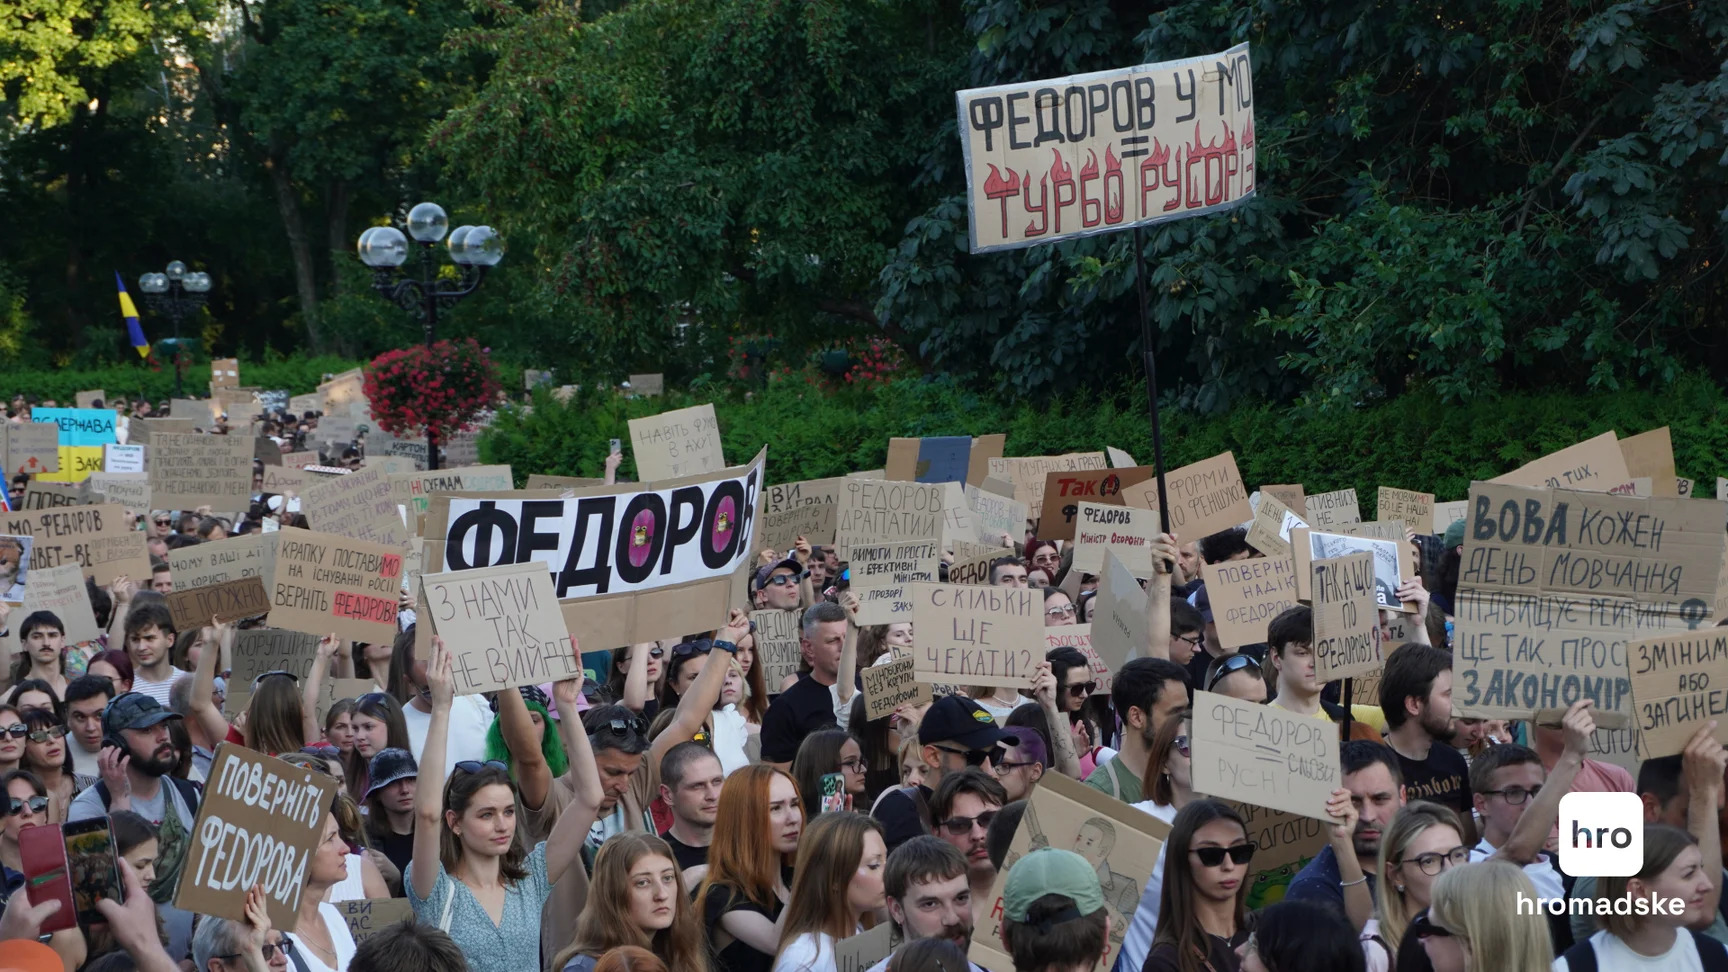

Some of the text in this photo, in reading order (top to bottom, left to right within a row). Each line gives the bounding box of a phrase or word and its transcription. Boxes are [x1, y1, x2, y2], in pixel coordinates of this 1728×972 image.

[969, 54, 1251, 151] ФЕДОРОВ У МО
[984, 160, 1125, 239] ТУРБО
[637, 423, 689, 447] НАВІТЬ
[75, 456, 103, 472] ЗАК
[669, 442, 680, 458] В
[991, 459, 1012, 474] ЧУТ
[1065, 458, 1077, 472] ЗА
[410, 477, 423, 495] НІ
[771, 484, 800, 504] ВИ
[847, 482, 942, 513] ФЕДОРОВ
[1026, 481, 1044, 497] ЧЕС
[1143, 466, 1230, 511] РФОРМИ
[1188, 479, 1246, 520] ФЕНШУЮ?
[1379, 489, 1390, 499] НЕ
[1083, 507, 1131, 525] ФЕДОРОВ
[1261, 501, 1283, 523] ДЕНЬ
[1315, 510, 1334, 526] НЕ
[1379, 499, 1391, 511] БО
[446, 463, 758, 598] ФЕДОРОВ
[1473, 494, 1665, 552] ВОВА, КОЖЕН
[172, 557, 203, 572] ЧОМУ
[211, 552, 240, 566] ВАШІ
[282, 541, 327, 565] КРАПКУ
[333, 548, 400, 577] ПОСТАВИМО
[851, 545, 892, 562] ВИМОГИ
[895, 543, 936, 560] ПРОСТІ:
[174, 581, 186, 591] НА
[192, 572, 230, 589] КОРИСТЬ
[288, 565, 363, 586] НА ІСНУВАННІ
[866, 559, 918, 576] ЕФЕКТИВНІ
[893, 570, 931, 583] МІНІСТРИ
[1217, 558, 1293, 585] ПОВЕРНІ
[1315, 562, 1343, 604] ТАК
[1343, 563, 1353, 600] А
[1351, 559, 1373, 597] ЩО
[1464, 547, 1537, 585] ДЕНЬ
[1549, 551, 1683, 596] МОВЧАННЯ
[275, 583, 397, 623] ВЕРНІТЬ ФЕДОРОВА
[435, 577, 538, 620] З НАМИ
[868, 588, 903, 601] ПРОЗОРІ
[891, 600, 913, 613] ЗАКУ
[931, 587, 1032, 617] СКІЛЬКИ
[1226, 600, 1292, 625] ФЕДОРОВ
[1342, 600, 1357, 629] ПО
[1459, 589, 1578, 632] ПІДВИЩУЄ
[485, 613, 540, 648] ТАК
[755, 611, 802, 641] ФЕДОР
[953, 617, 993, 646] ЩЕ
[450, 637, 579, 692] НЕ ВИЙДЕ
[927, 649, 1031, 678] ЧЕКАТИ?
[1460, 632, 1494, 667] ЦЕ
[1501, 634, 1552, 668] ТАК,
[1636, 635, 1728, 674] ЗМІНИМ
[868, 681, 884, 696] БЕЗ
[1461, 669, 1631, 712] ЗАКОНОМІР
[1679, 672, 1709, 692] АБО
[870, 686, 919, 715] ФЕДОРОВИМ
[1643, 690, 1728, 731] ЗАГИНЕ
[1212, 704, 1326, 757] ФЕДОРОВ
[217, 753, 324, 829] ПОВЕРНІТЬ
